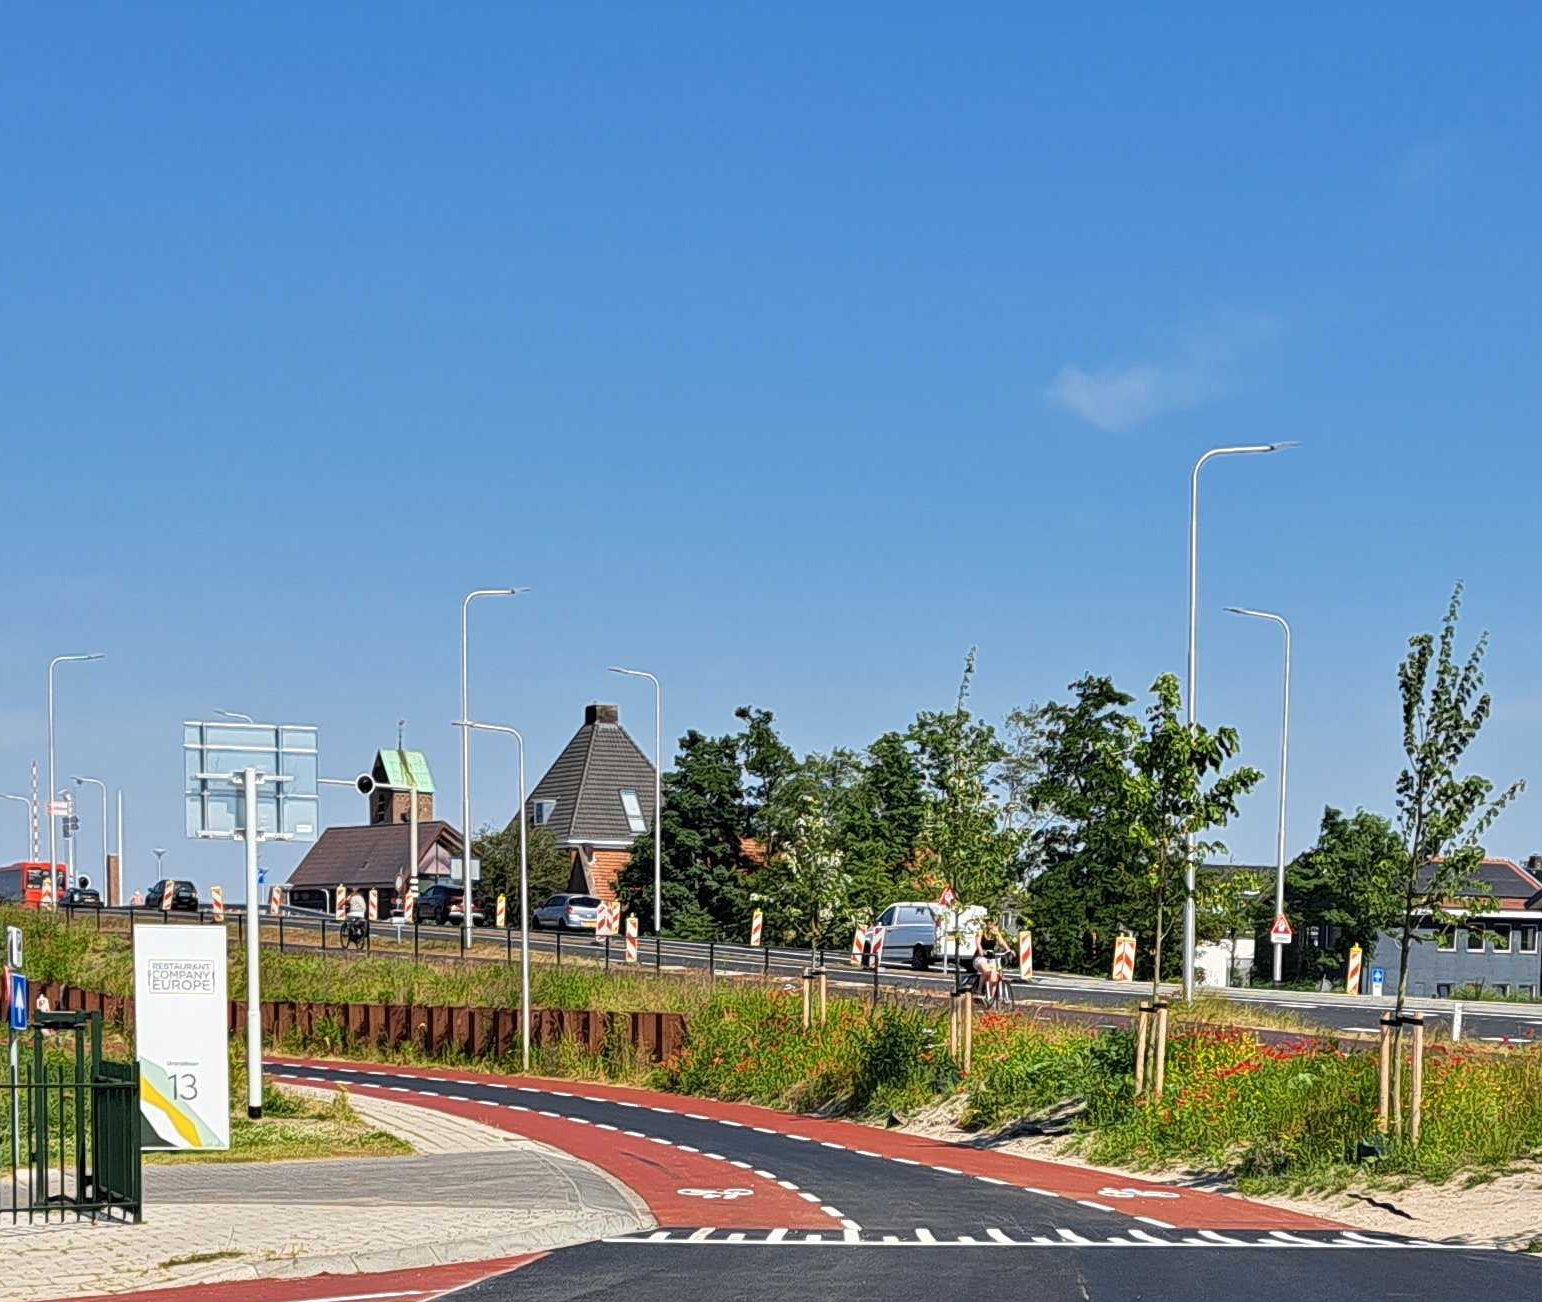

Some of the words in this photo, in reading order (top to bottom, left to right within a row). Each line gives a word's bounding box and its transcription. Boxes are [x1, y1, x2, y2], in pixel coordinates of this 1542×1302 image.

[152, 962, 211, 970] RESTAURANT
[152, 970, 211, 979] COMPANY
[152, 979, 211, 991] EUROPE
[167, 1073, 198, 1101] 13
